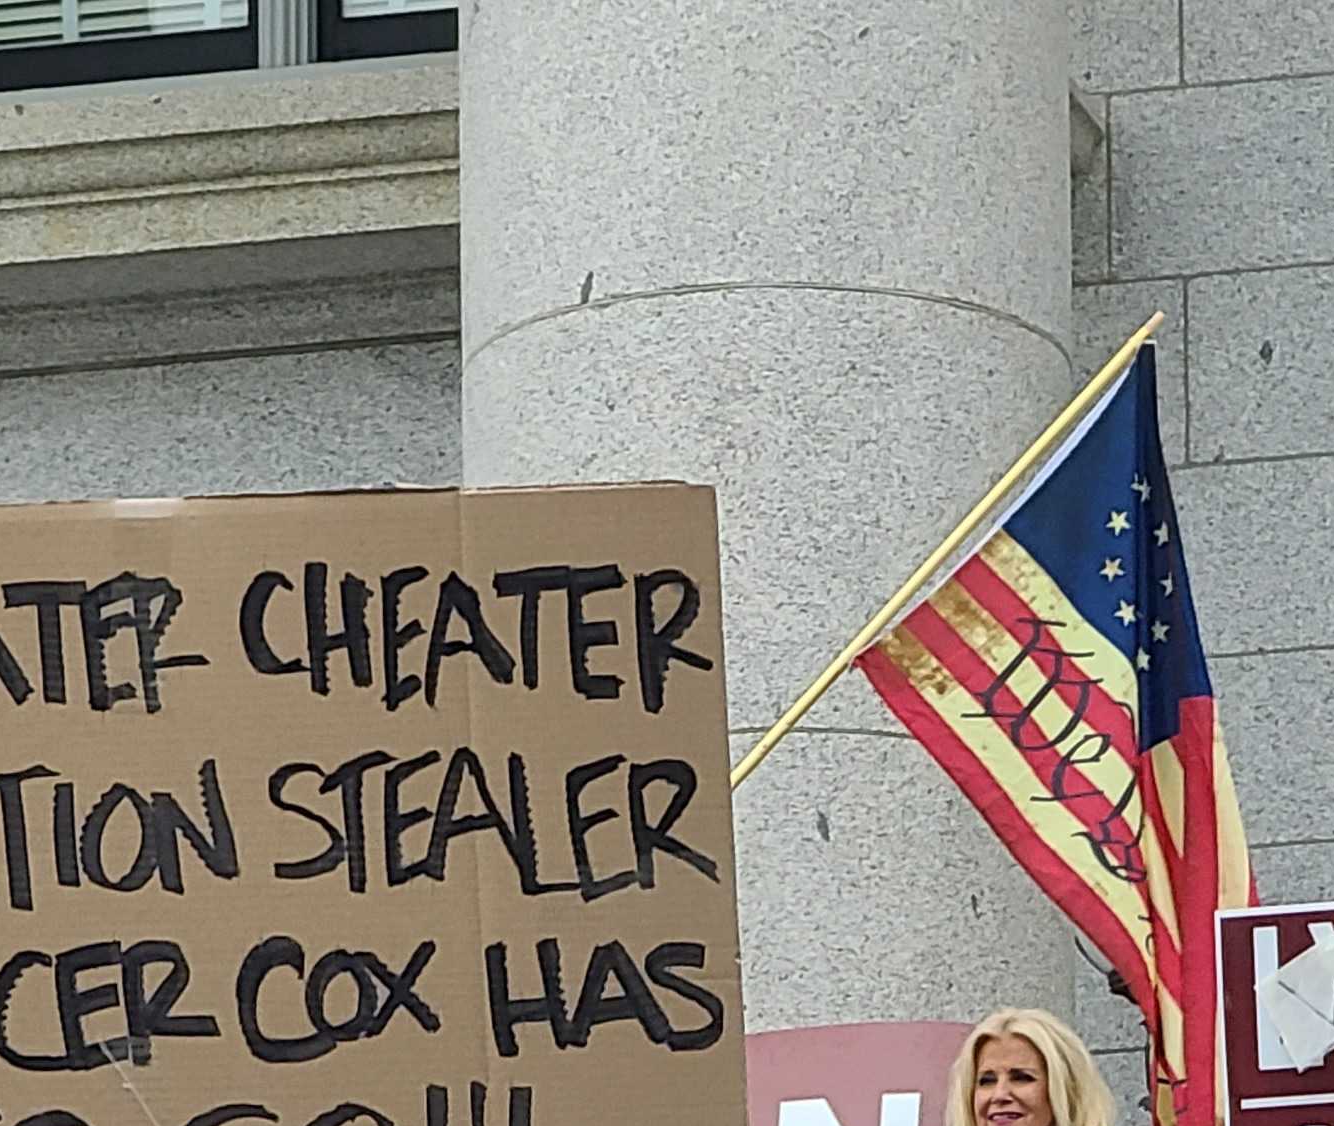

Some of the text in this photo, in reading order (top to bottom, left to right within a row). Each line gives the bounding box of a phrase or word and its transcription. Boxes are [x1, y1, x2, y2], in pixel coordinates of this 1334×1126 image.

[239, 561, 713, 713] CHEATER
[269, 749, 720, 903] STEALER
[235, 934, 442, 1065] COX
[485, 936, 725, 1057] HAS
